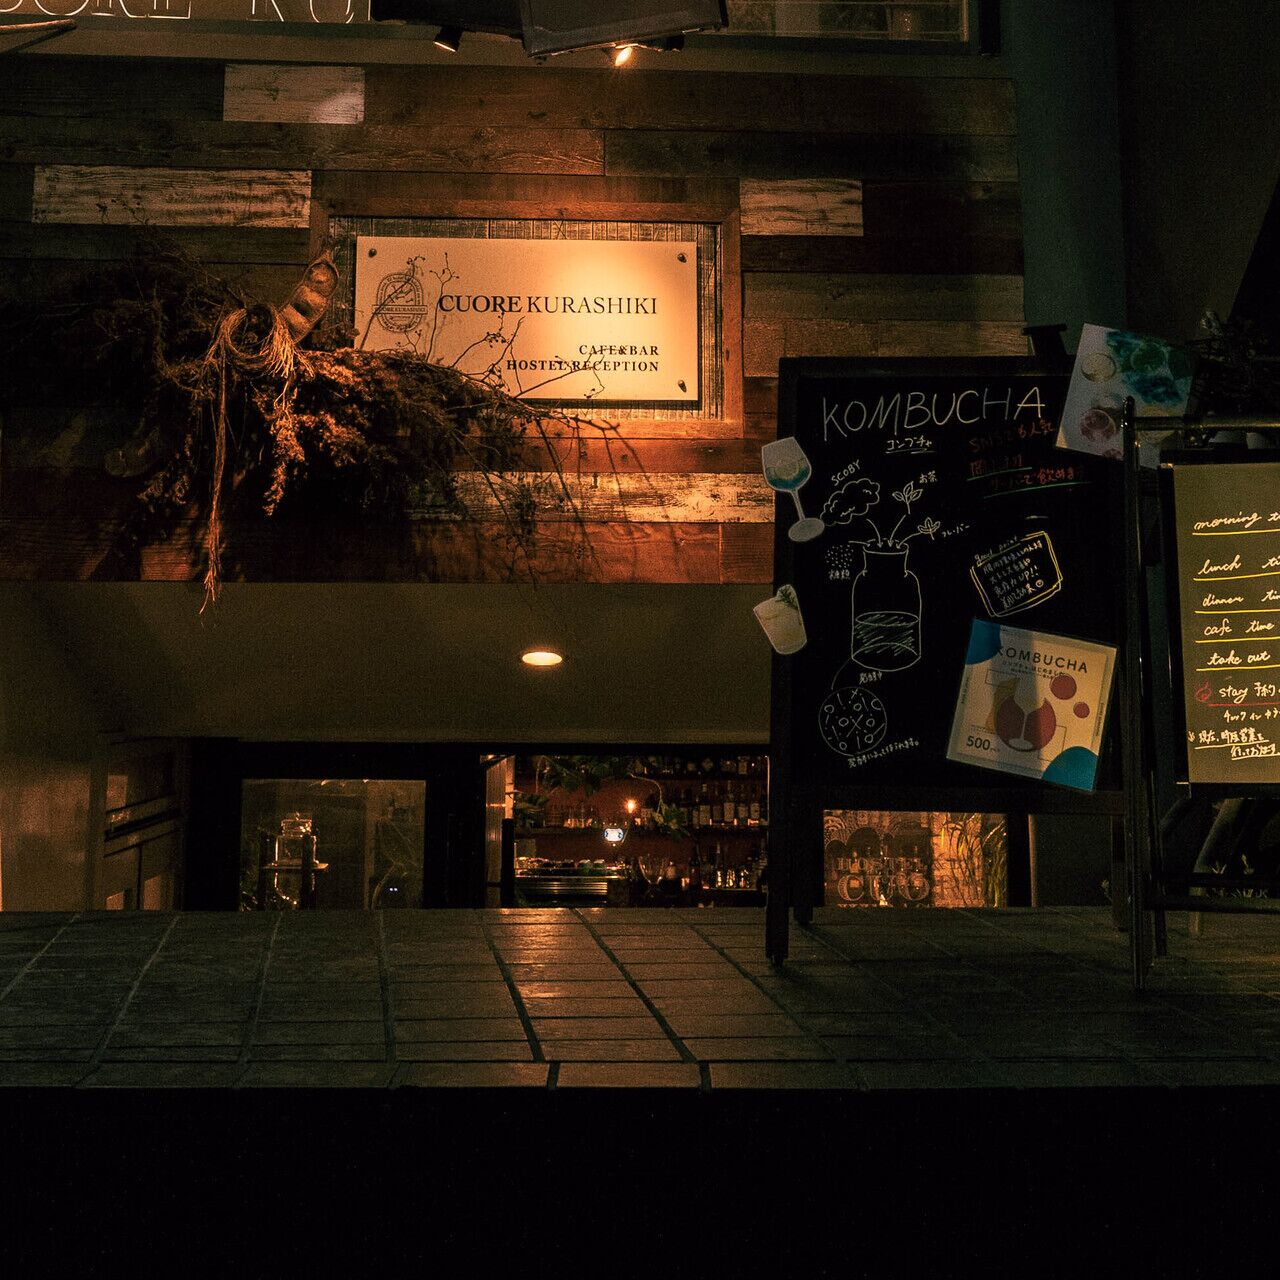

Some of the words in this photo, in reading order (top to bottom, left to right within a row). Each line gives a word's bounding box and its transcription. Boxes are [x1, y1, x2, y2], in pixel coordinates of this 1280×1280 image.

[438, 294, 523, 314] CUORE
[526, 296, 658, 315] KURASHIKI
[578, 344, 659, 356] CAFE&BAR
[822, 385, 1046, 441] KOMBUCHA
[887, 437, 934, 452] コンブチャ
[830, 458, 862, 486] SCOBY
[919, 470, 938, 484] お茶
[1193, 511, 1262, 532] morning
[1197, 554, 1241, 576] lunch
[1202, 592, 1244, 607] dinner
[1203, 618, 1232, 636] cafe
[1245, 620, 1275, 633] time
[997, 646, 1089, 674] KOMBUCHA
[1207, 650, 1242, 666] take
[1247, 651, 1271, 664] out
[1219, 685, 1249, 704] stay
[966, 735, 991, 751] 500
